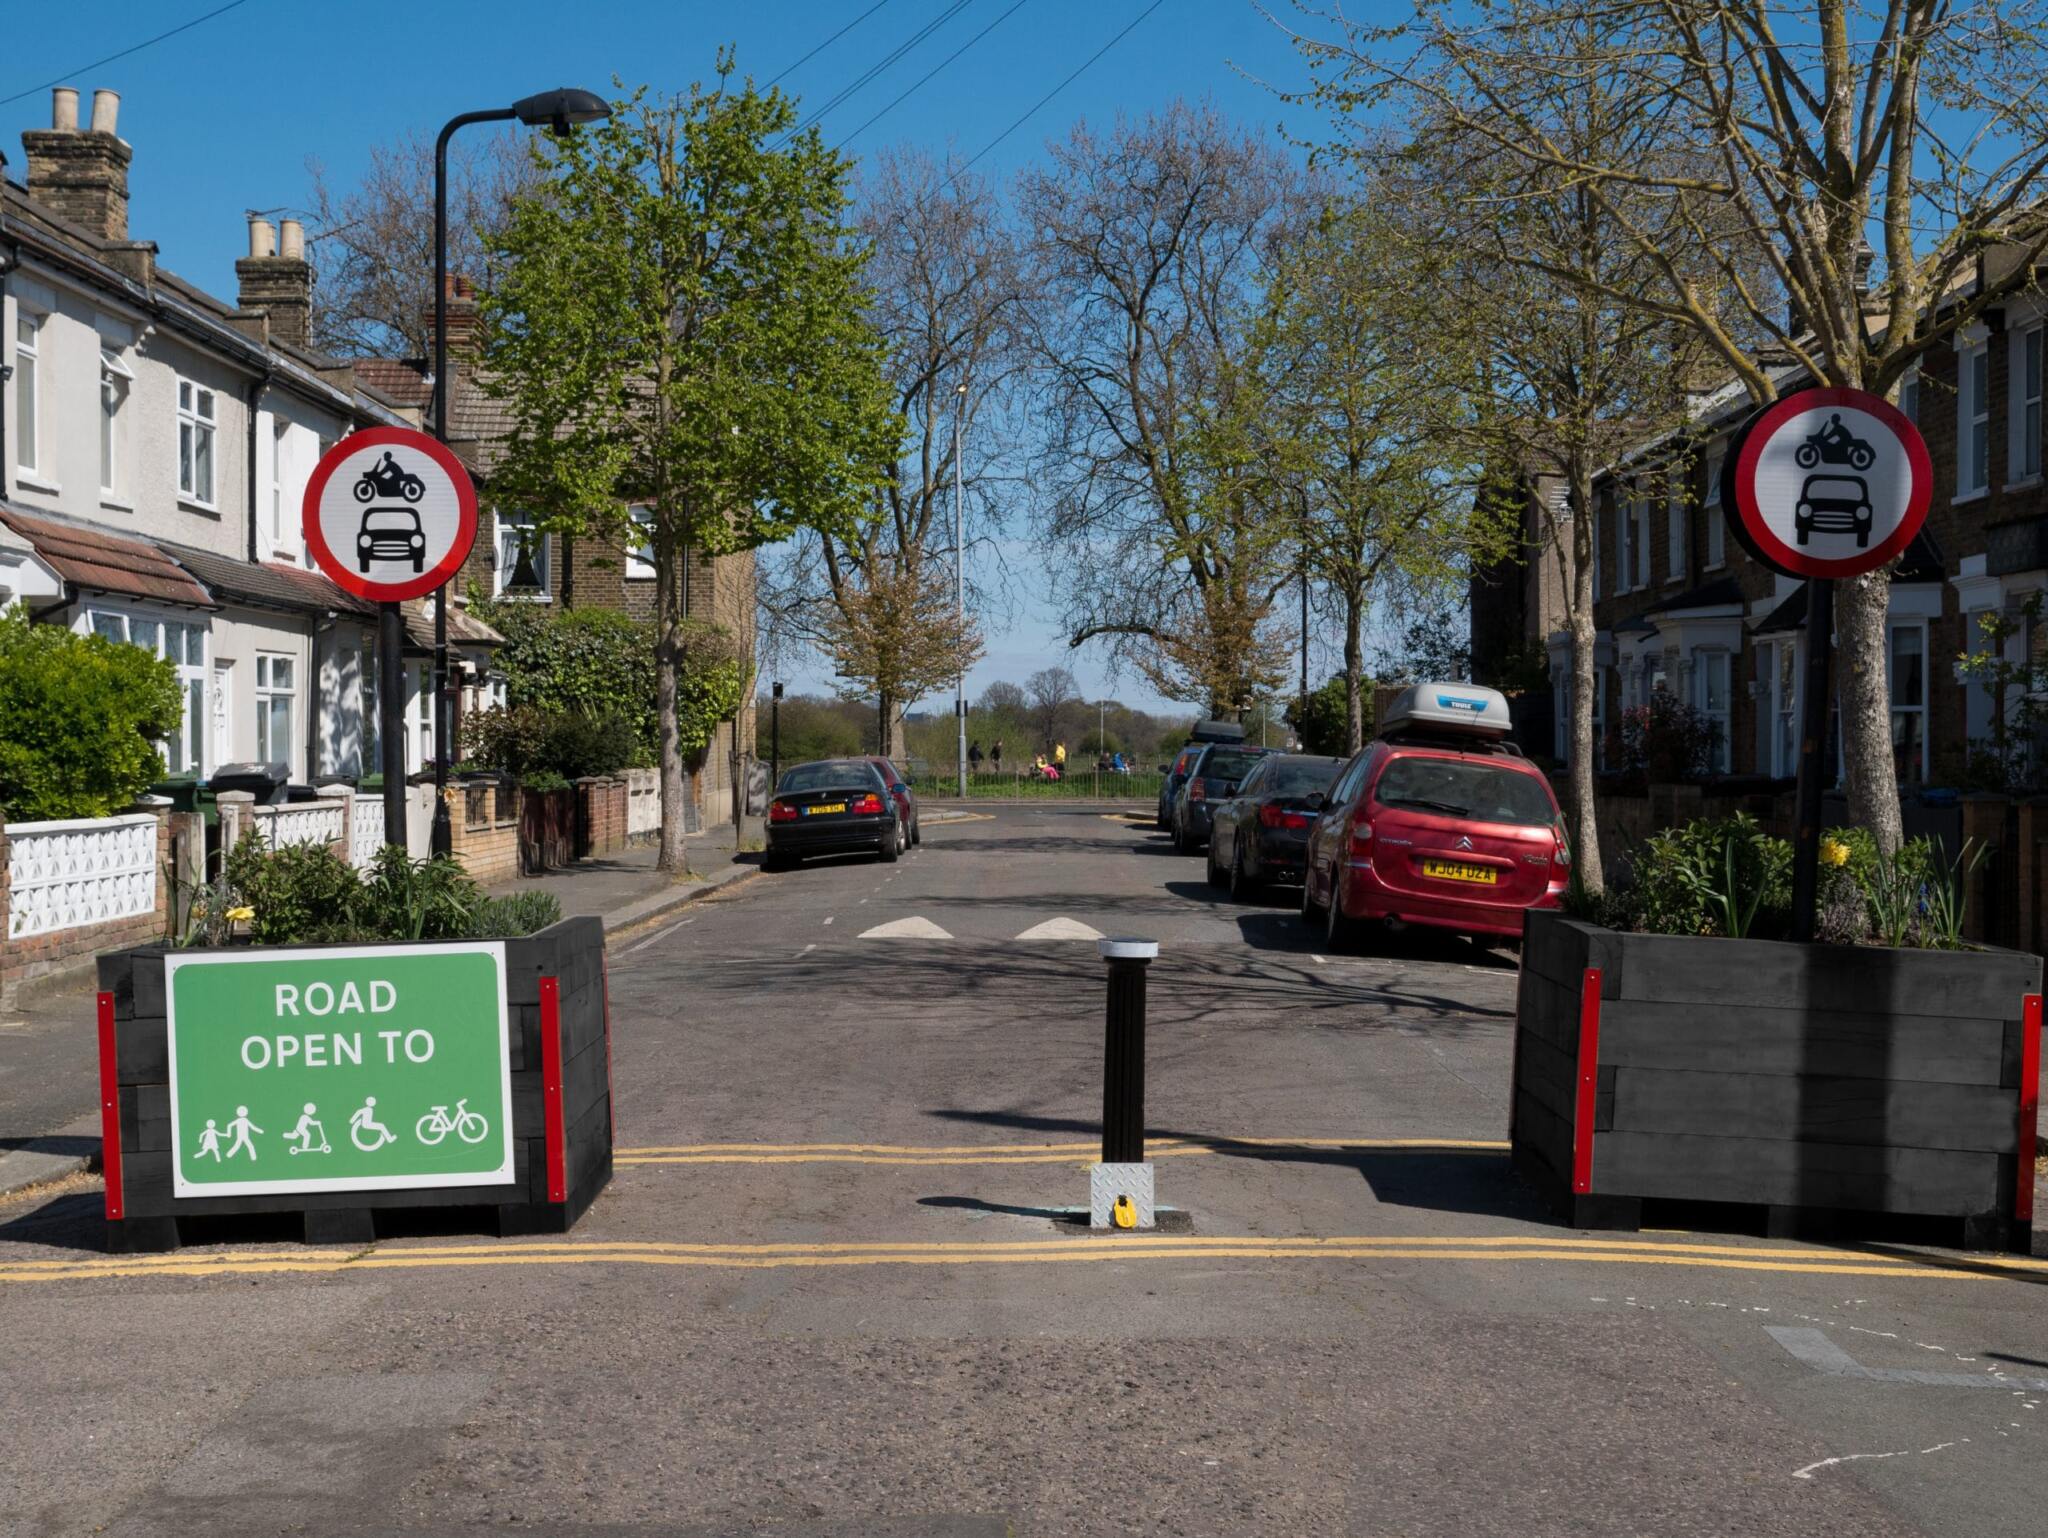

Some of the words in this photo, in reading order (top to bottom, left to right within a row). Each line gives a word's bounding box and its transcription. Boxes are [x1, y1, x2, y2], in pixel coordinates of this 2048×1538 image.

[275, 980, 397, 1016] ROAD
[238, 1032, 362, 1069] OPEN
[378, 1029, 434, 1063] TO
